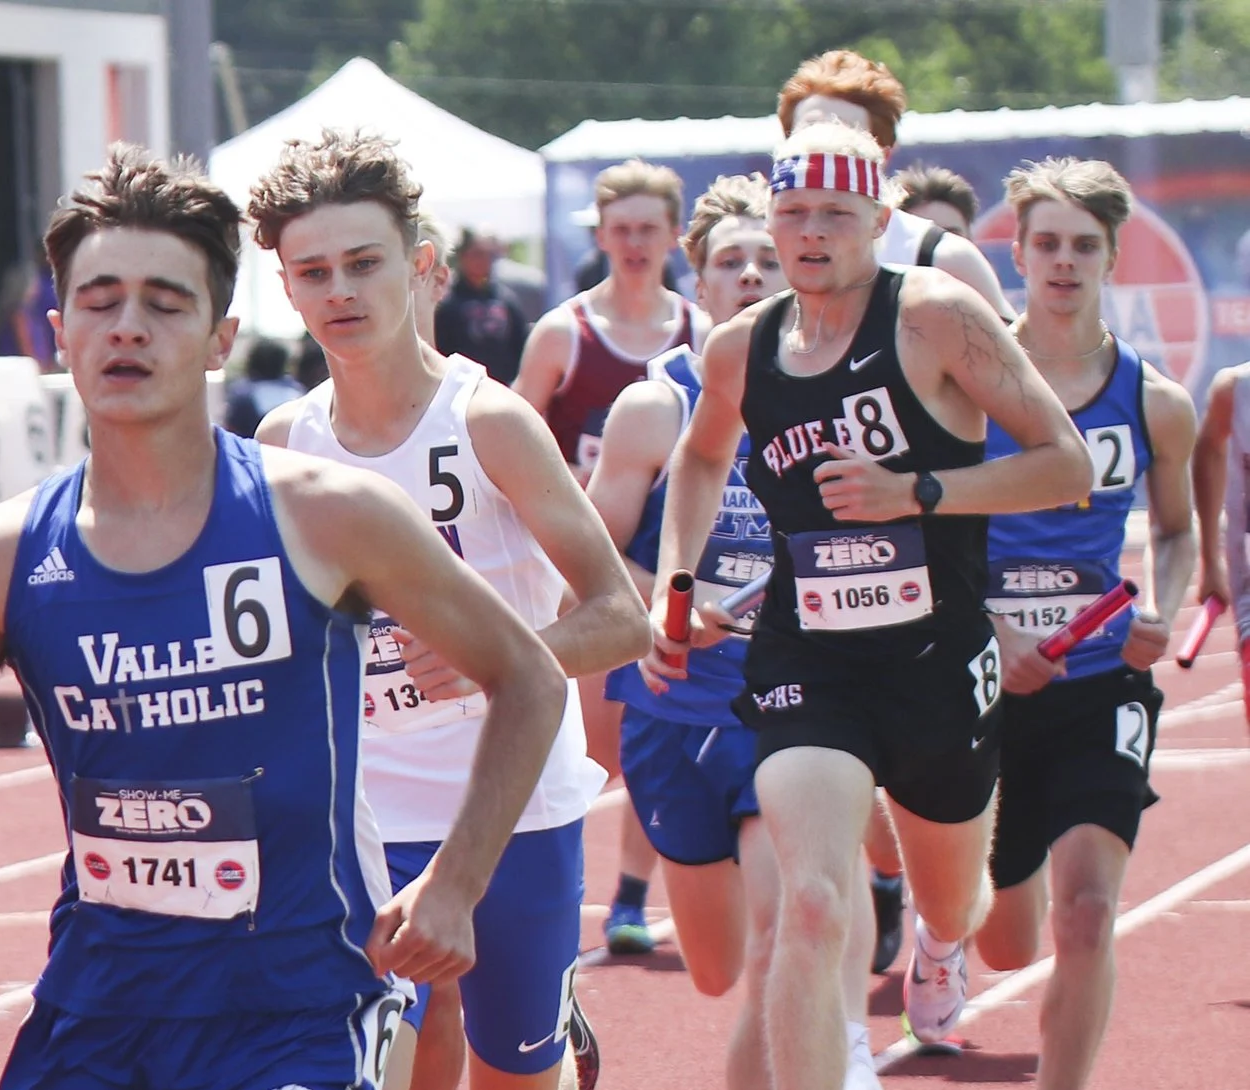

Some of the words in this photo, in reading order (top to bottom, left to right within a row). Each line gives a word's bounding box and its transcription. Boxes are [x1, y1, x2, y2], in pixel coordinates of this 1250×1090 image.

[854, 396, 894, 456] 8
[1097, 430, 1126, 487] 2
[429, 444, 464, 522] 5
[715, 555, 771, 581] ZER
[814, 543, 896, 568] ZERO
[28, 569, 75, 585] adidas
[1002, 570, 1079, 591] ZERO
[223, 566, 270, 658] 6
[833, 585, 889, 610] 1056
[1017, 606, 1066, 627] 1152
[78, 632, 223, 685] VALLE
[980, 651, 997, 706] 8
[1126, 702, 1143, 757] 2
[118, 789, 182, 800] SHOW-ME
[95, 797, 211, 830] ZERO
[122, 856, 197, 888] 1741
[376, 997, 402, 1080] 6
